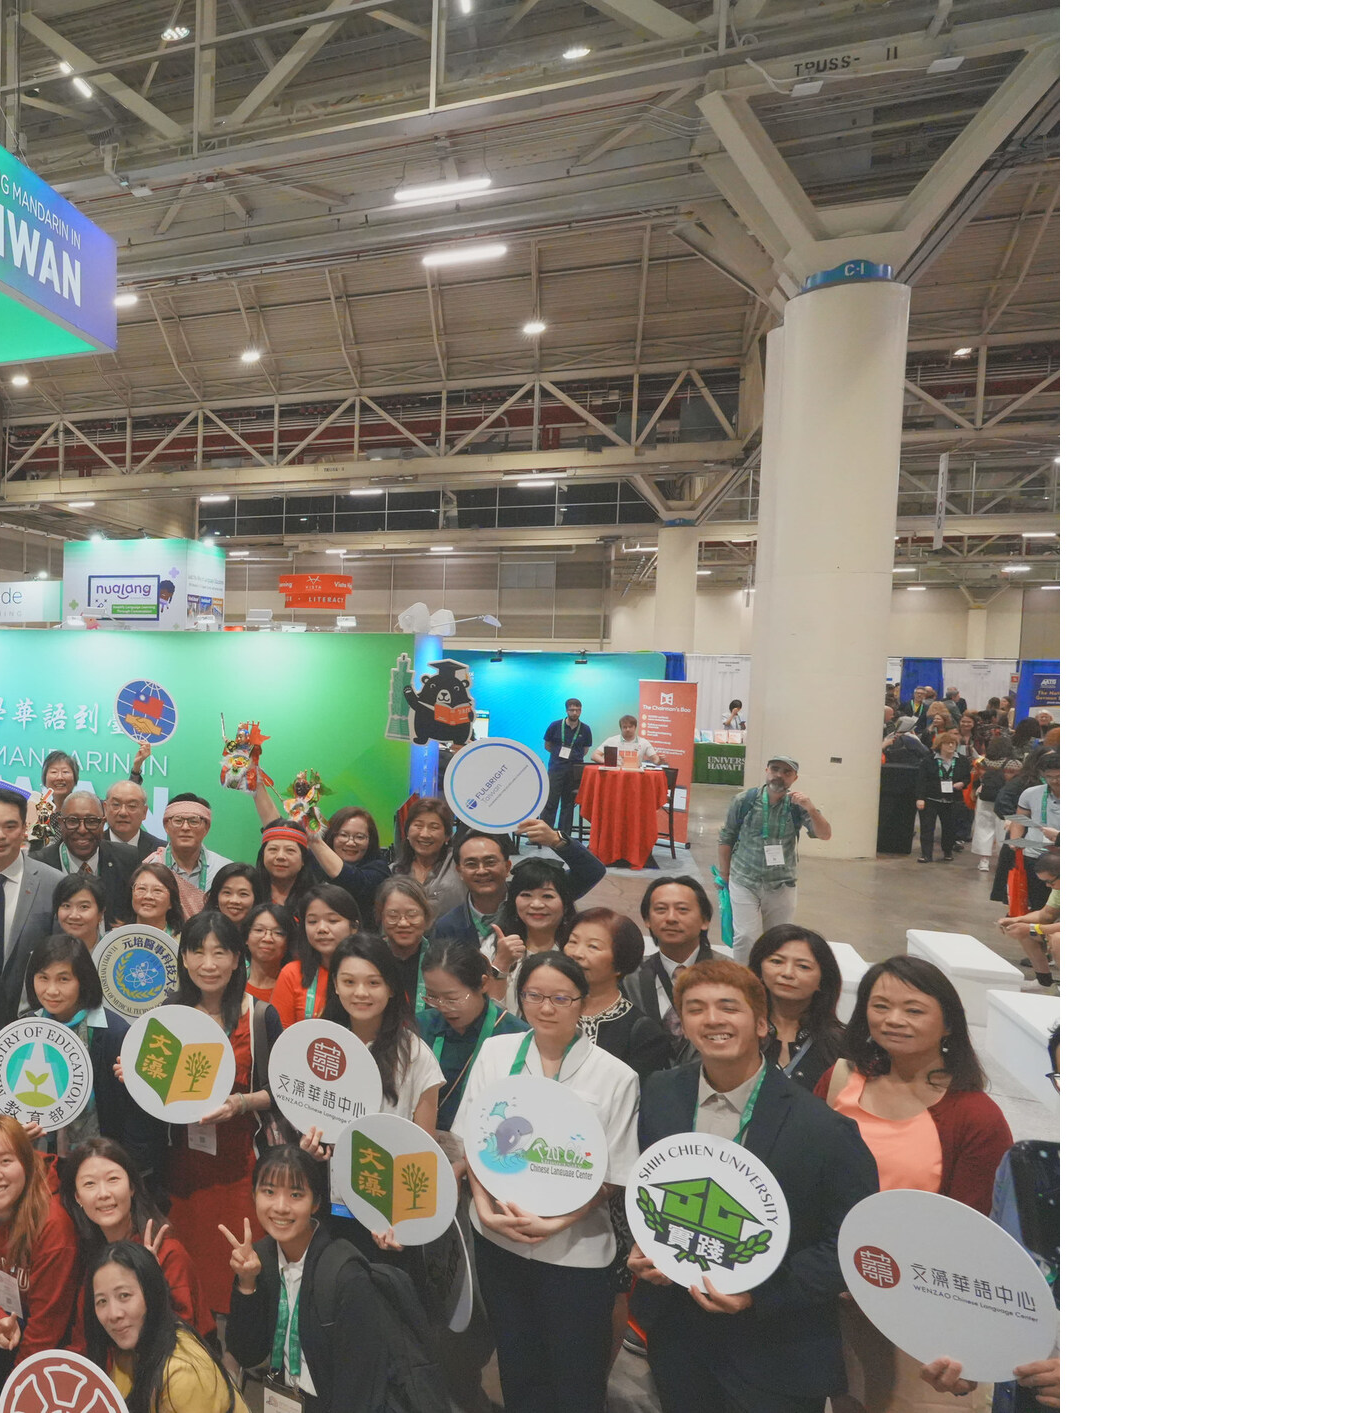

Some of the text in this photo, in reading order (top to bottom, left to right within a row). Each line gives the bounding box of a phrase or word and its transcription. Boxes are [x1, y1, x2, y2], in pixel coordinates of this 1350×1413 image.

[12, 182, 69, 241] MANDARIN
[71, 228, 81, 250] IN
[96, 583, 152, 598] nualang
[475, 763, 508, 800] FULBRIGHT
[481, 783, 503, 804] Taiwan
[112, 997, 133, 1014] MEDICAL
[23, 1026, 44, 1039] OF
[46, 1028, 84, 1109] EDUCATION
[140, 1034, 173, 1080] 文藻
[4, 1099, 66, 1126] 教育部
[275, 1093, 348, 1124] WENZAO Chinese Language
[277, 1073, 366, 1119] 文藻華語中心
[358, 1147, 387, 1198] 文藻
[529, 1163, 550, 1175] Chinese
[550, 1166, 575, 1178] Language
[575, 1169, 593, 1180] Center
[638, 1144, 779, 1226] SHIH CHIEN UNIVERSITY
[666, 1223, 726, 1264] 實踐
[910, 1262, 1037, 1313] 文藻華語中心
[912, 1283, 1039, 1323] WENZAO Chinese Language Center
